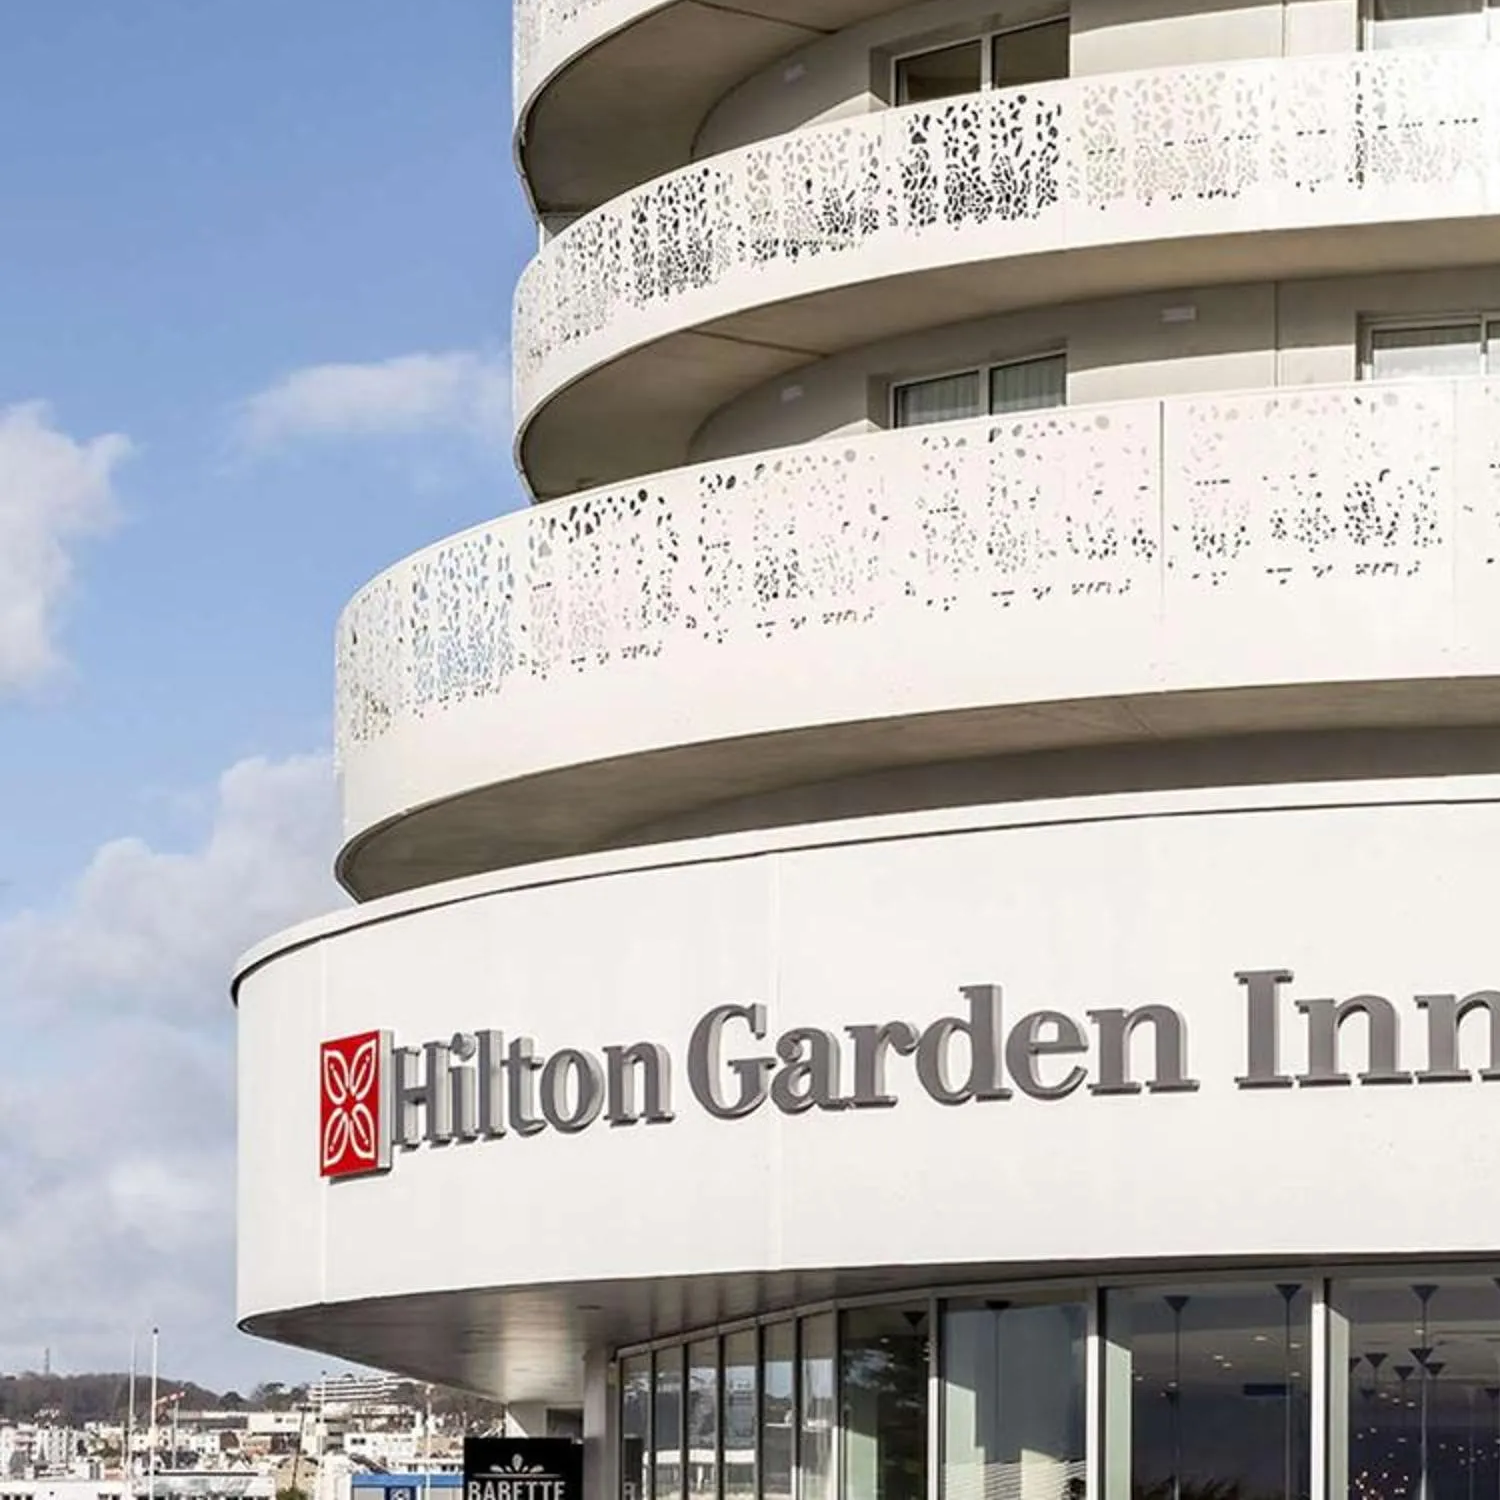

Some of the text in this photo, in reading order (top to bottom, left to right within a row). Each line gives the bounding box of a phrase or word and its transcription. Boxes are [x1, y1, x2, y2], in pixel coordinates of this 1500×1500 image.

[391, 1029, 675, 1151] Hilton
[687, 983, 1200, 1120] Garden
[467, 1481, 566, 1500] BABETTE
